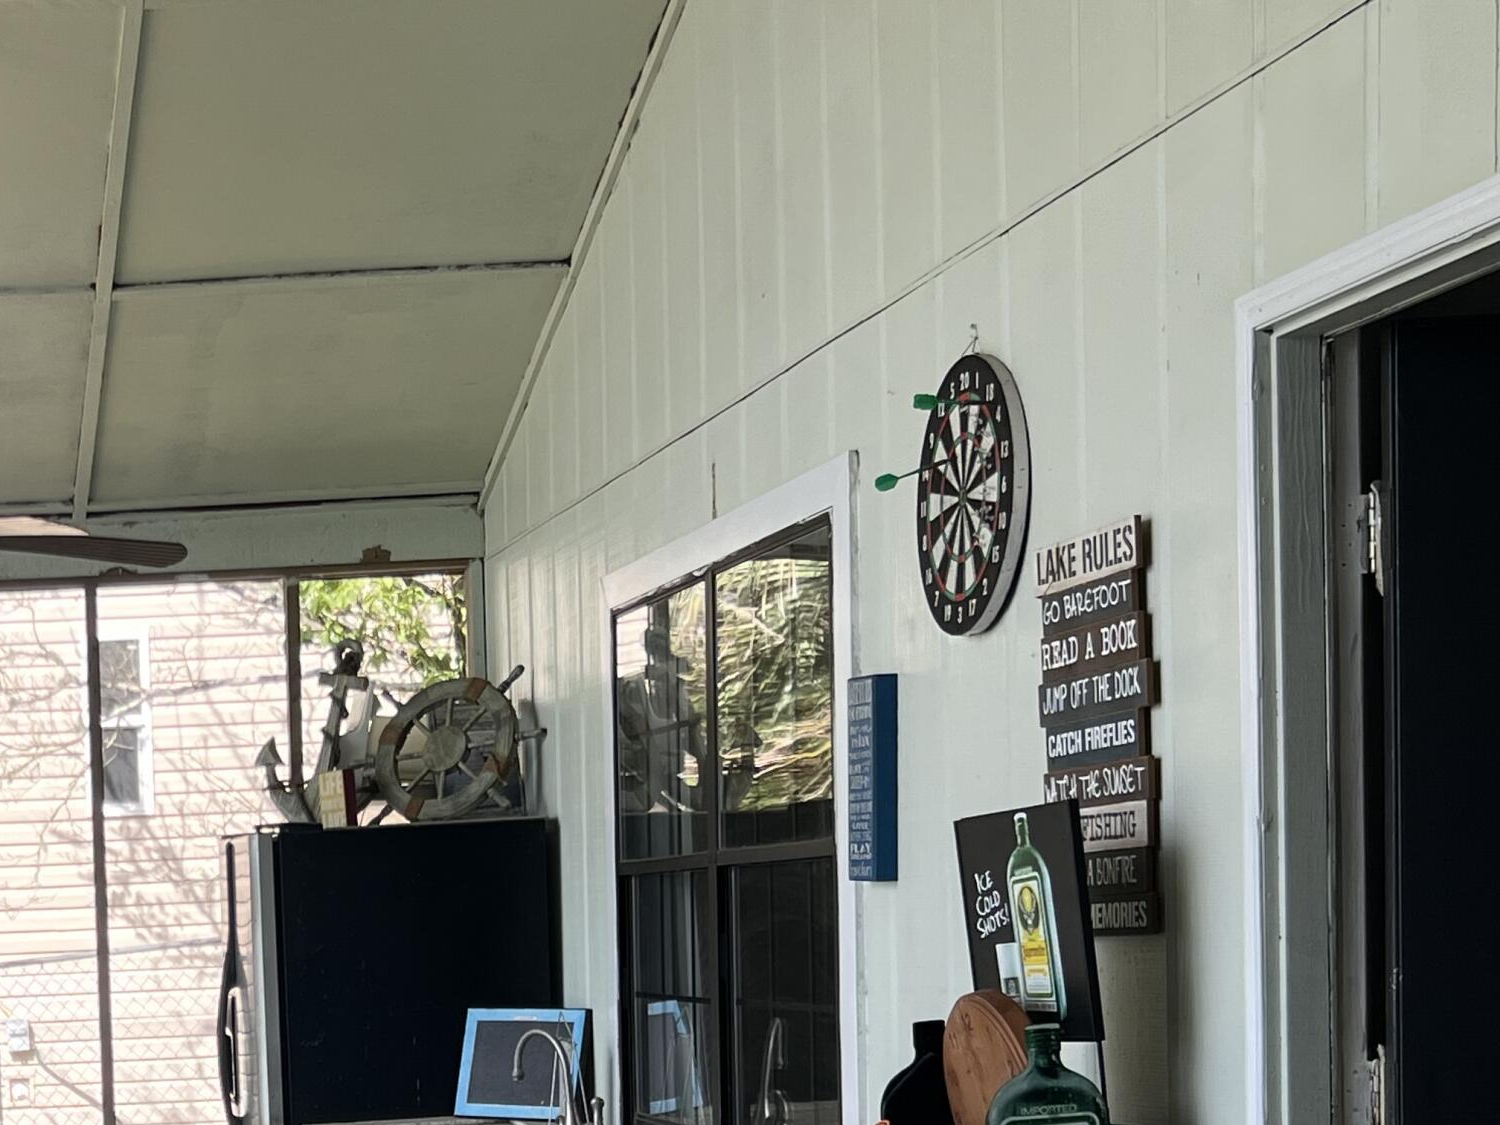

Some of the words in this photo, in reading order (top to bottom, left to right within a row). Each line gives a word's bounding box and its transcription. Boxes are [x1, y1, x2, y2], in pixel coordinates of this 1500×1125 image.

[950, 382, 955, 399] 5
[960, 371, 970, 391] 20
[985, 383, 994, 401] 18
[1000, 440, 1009, 458] 13
[1001, 476, 1007, 493] 6
[1036, 542, 1077, 586] LAKE
[1082, 524, 1134, 574] RULES
[934, 591, 939, 607] 7
[982, 578, 988, 596] 2
[968, 599, 976, 616] 17
[1043, 601, 1060, 625] GO
[1063, 579, 1132, 619] BAREFOOT
[957, 606, 963, 624] 3
[1041, 636, 1078, 671] READ
[1084, 632, 1095, 660] A
[1100, 619, 1138, 656] BOOK
[1042, 683, 1068, 715] JUMP
[1070, 678, 1090, 709] OFF
[1092, 673, 1112, 704] THE
[1114, 666, 1142, 699] DOCK
[1048, 730, 1083, 758] CATCH
[1085, 719, 1135, 751] FIREFLIES
[1044, 773, 1078, 804] WATCH
[1079, 769, 1101, 800] THE
[1102, 763, 1145, 797] SUNSET
[1080, 810, 1137, 842] FISHING
[974, 870, 993, 894] ICE
[1096, 855, 1137, 886] BONFIRE
[976, 890, 1000, 916] COLD
[976, 902, 1010, 938] SHOTS!
